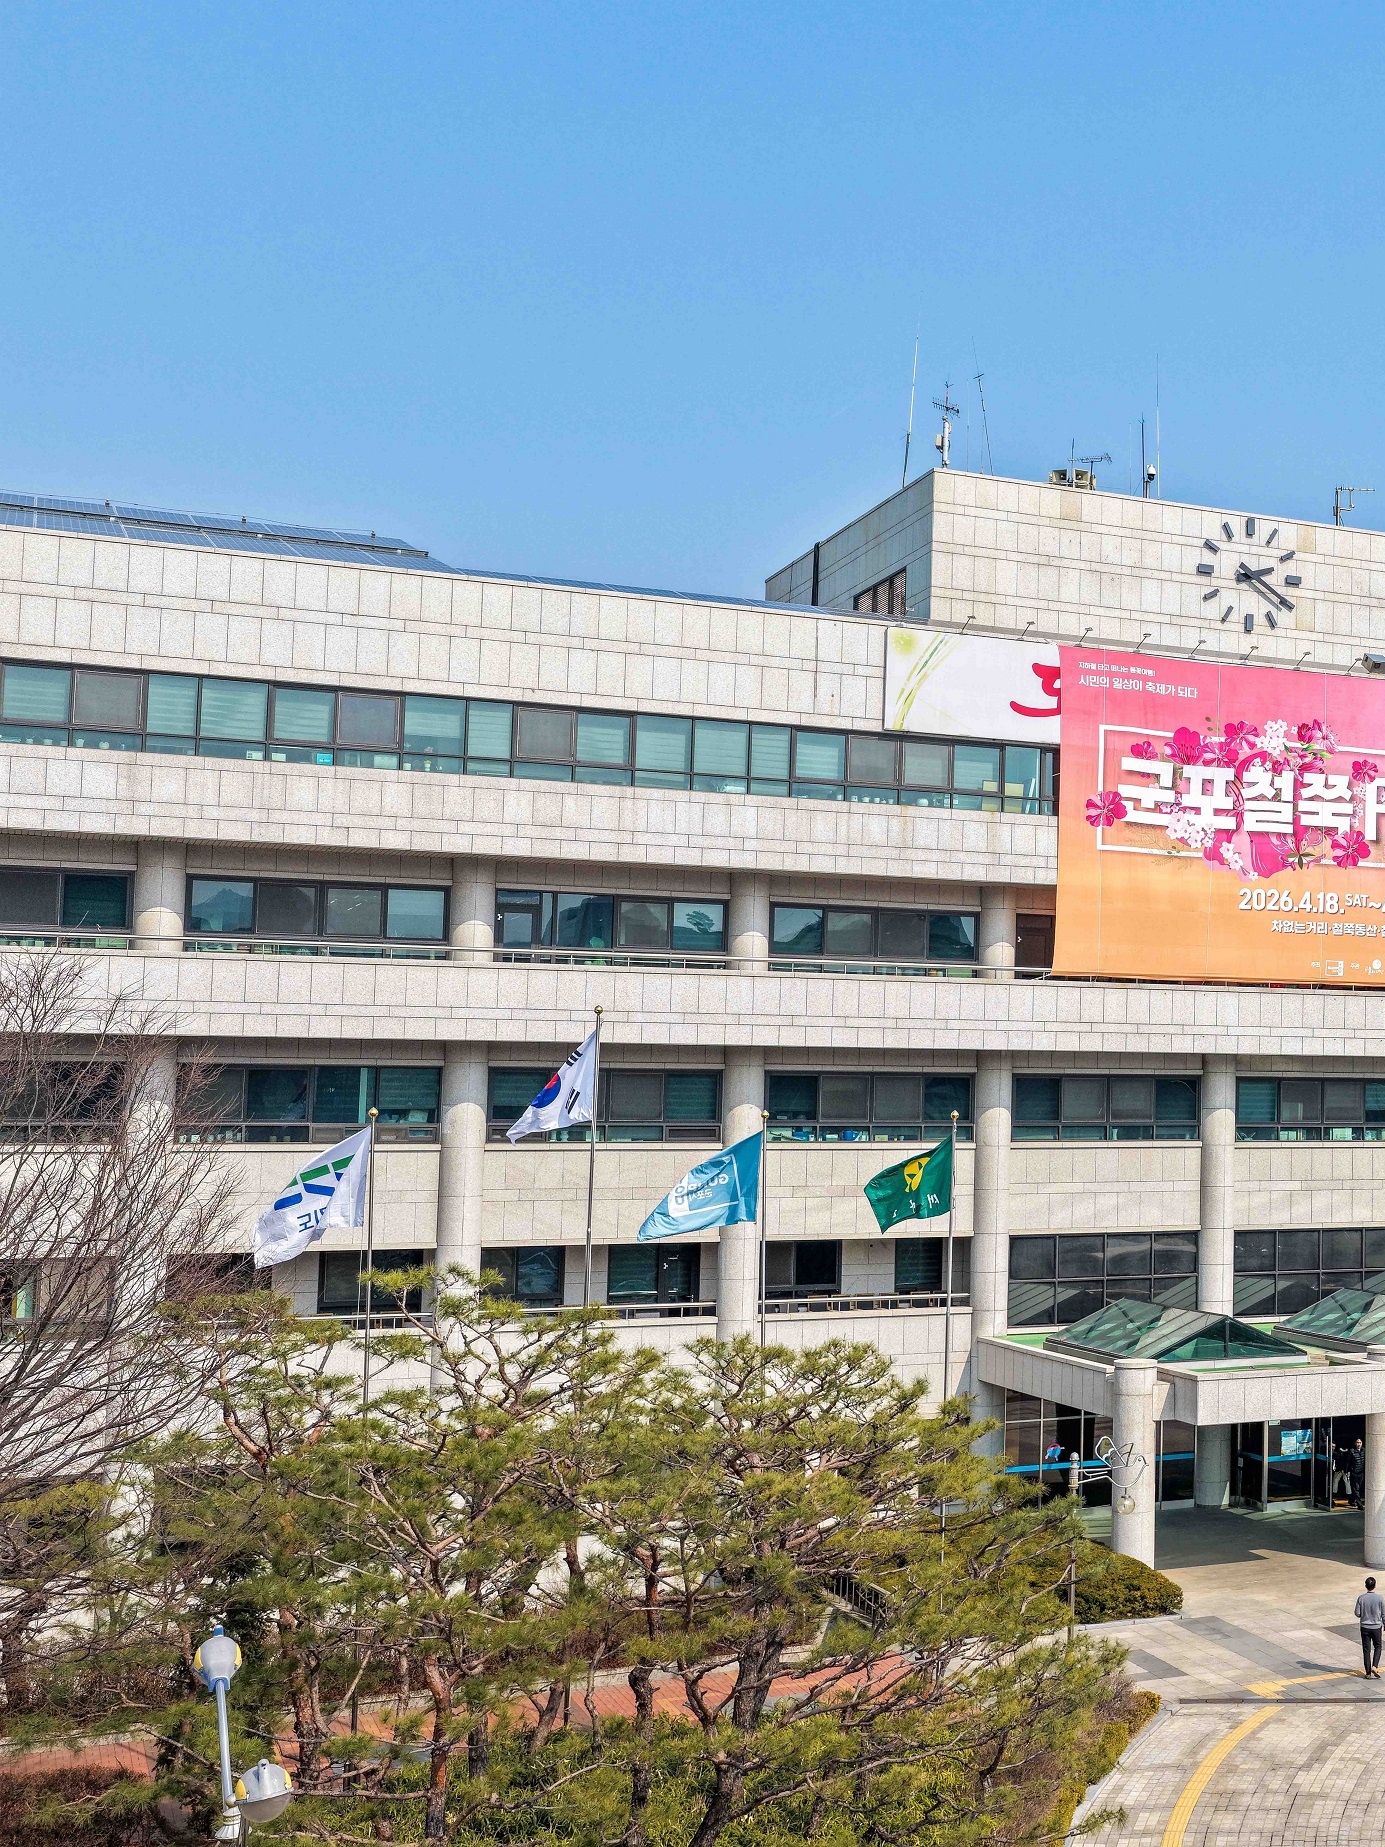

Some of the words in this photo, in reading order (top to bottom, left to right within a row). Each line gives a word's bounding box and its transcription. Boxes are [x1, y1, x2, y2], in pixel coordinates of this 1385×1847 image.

[1078, 674, 1109, 688] 시민의
[1112, 677, 1142, 692] 일상이
[1145, 681, 1175, 696] 축제가
[1177, 686, 1198, 698] 되다
